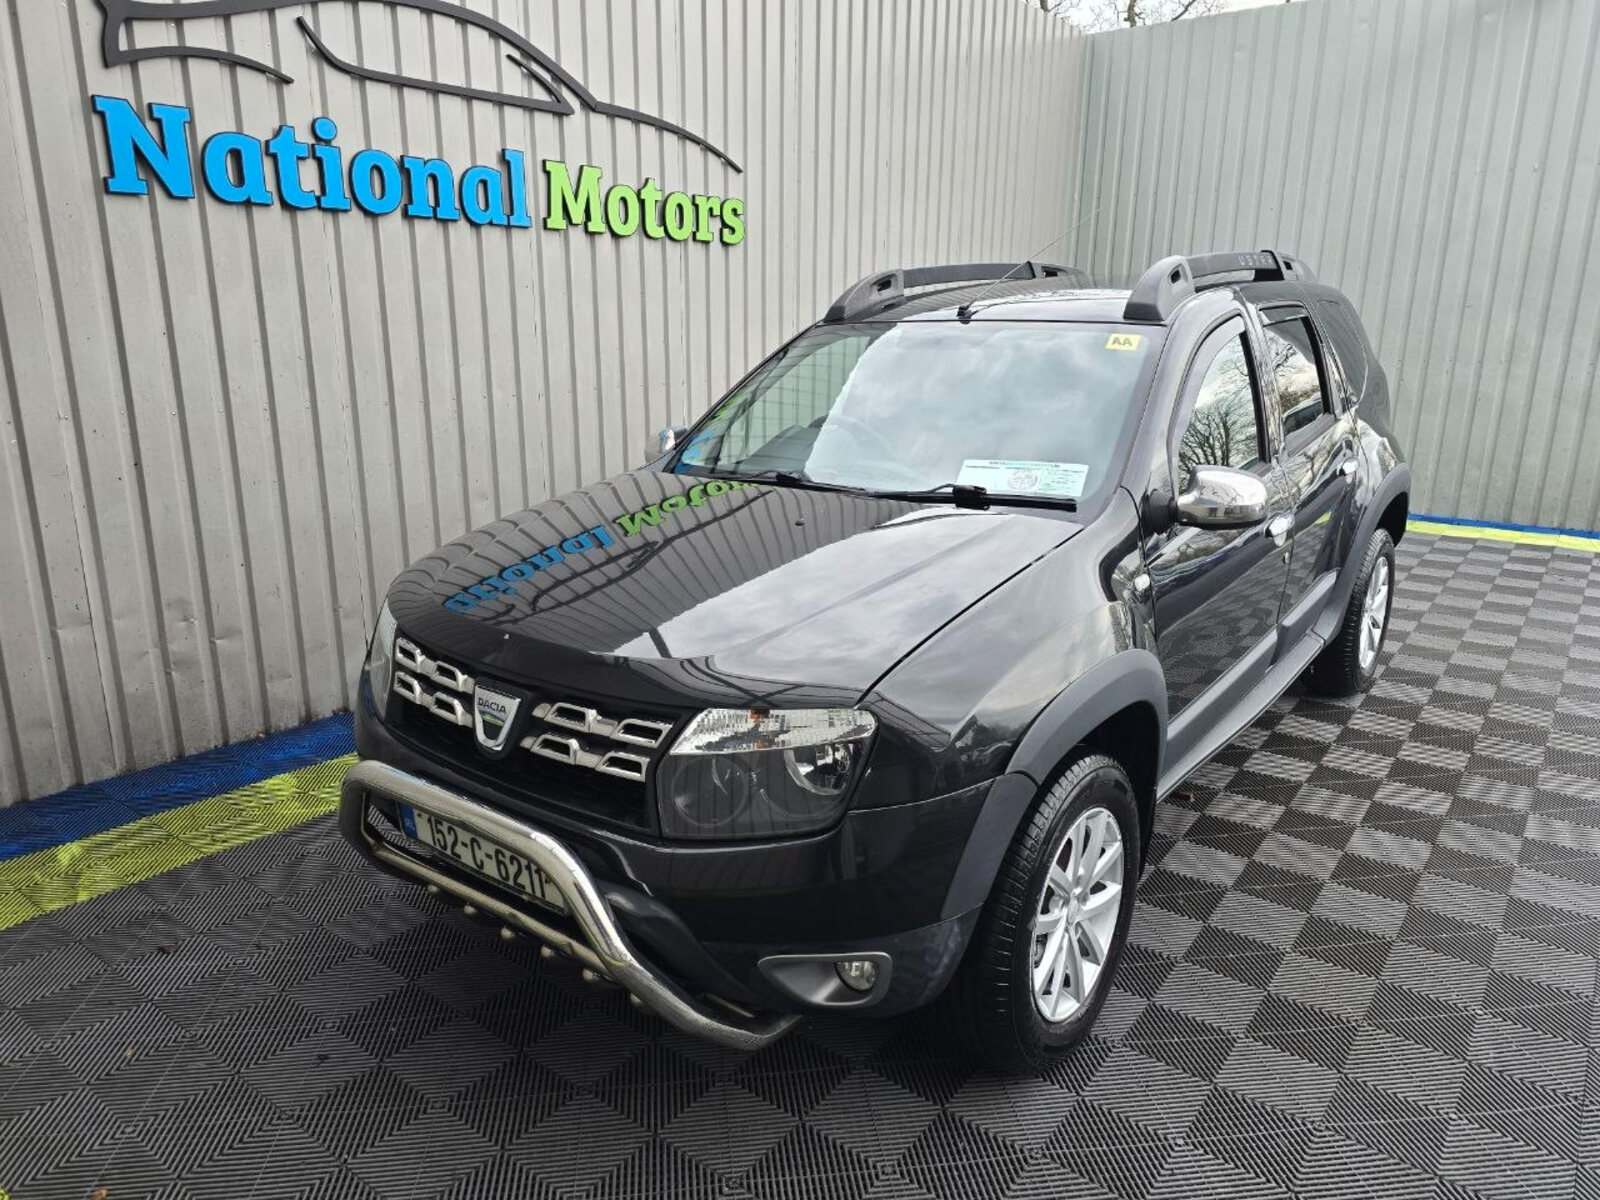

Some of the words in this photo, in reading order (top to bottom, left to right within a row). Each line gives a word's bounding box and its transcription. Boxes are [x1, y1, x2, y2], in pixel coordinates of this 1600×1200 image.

[91, 94, 532, 229] National
[542, 159, 747, 245] Motors
[1111, 336, 1133, 347] AA
[476, 697, 507, 714] DACIA
[427, 814, 547, 900] 152-C-6211
